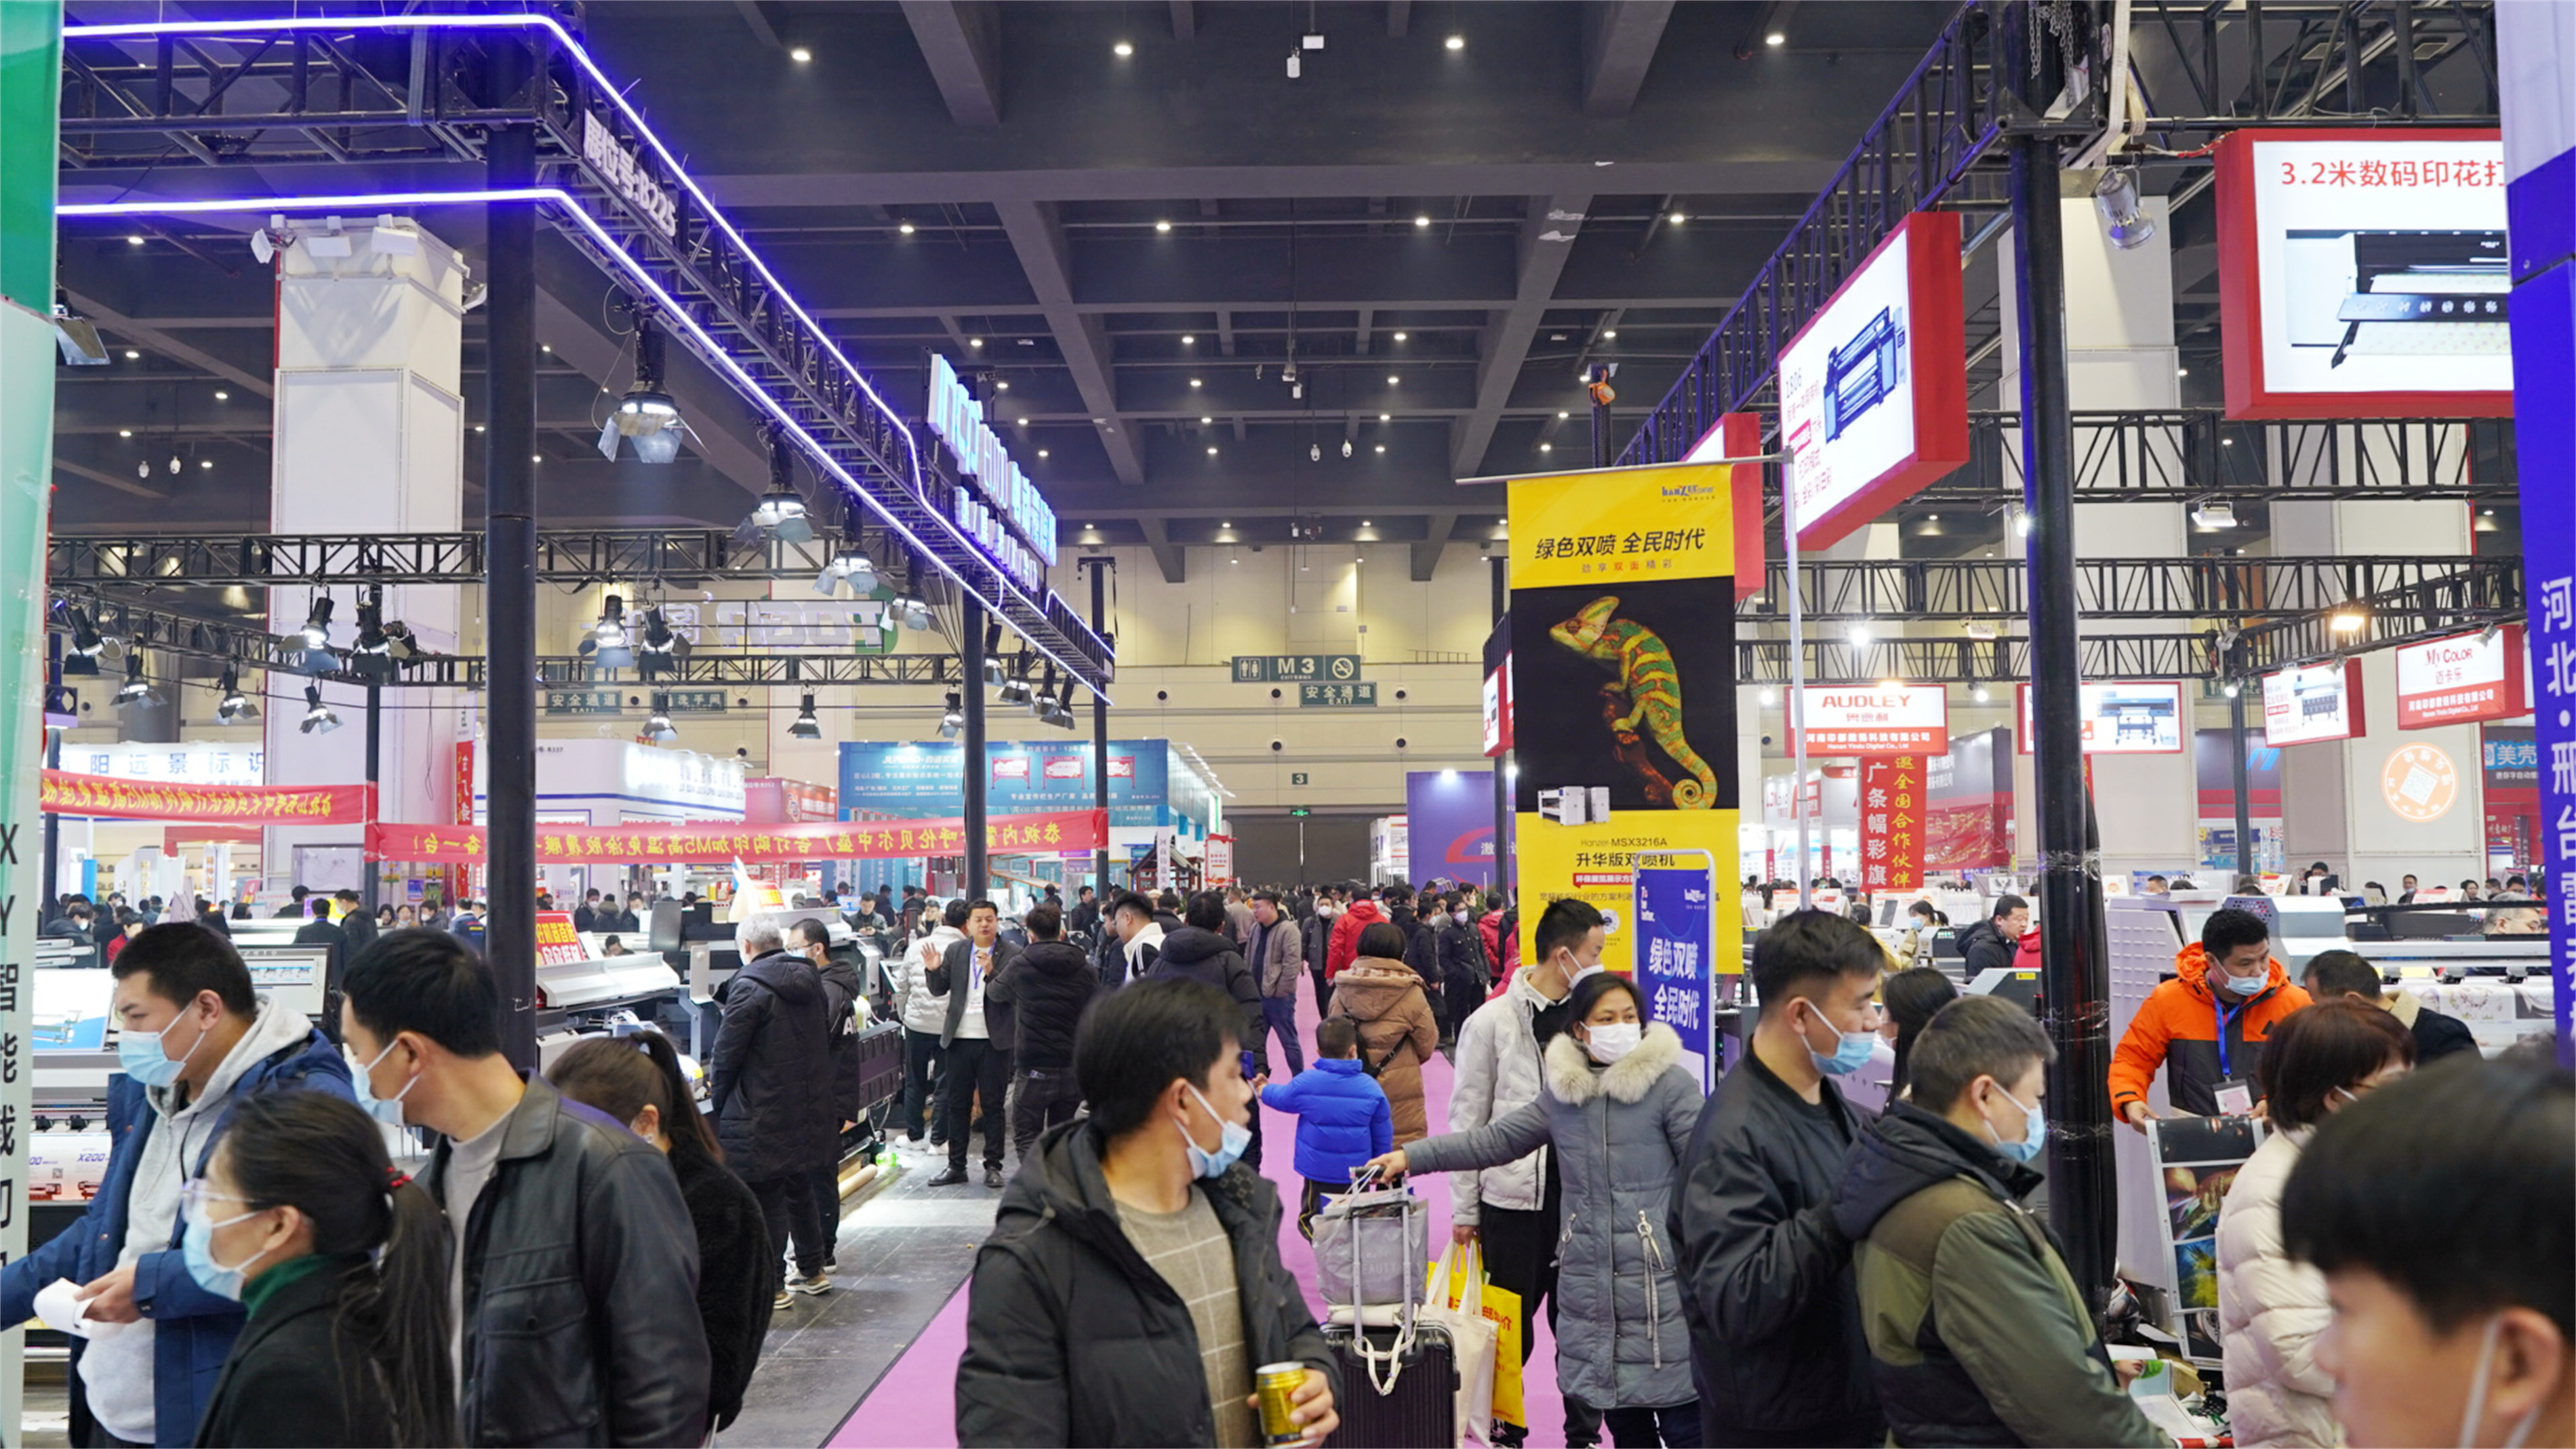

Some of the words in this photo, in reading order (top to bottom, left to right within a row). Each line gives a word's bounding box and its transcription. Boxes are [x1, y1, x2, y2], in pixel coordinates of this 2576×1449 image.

[1535, 534, 1616, 559] 绿色双喷
[1622, 528, 1706, 554] 全民时代
[1582, 559, 1672, 574] 劲享双面精彩
[1306, 685, 1371, 699] 安全通道
[552, 694, 617, 707] 安全通道
[1822, 694, 1911, 708] AUDLEY
[1295, 774, 1304, 784] 3
[1576, 852, 1675, 868] 升华版双喷机
[1649, 936, 1699, 981] 绿色双喷
[1653, 984, 1699, 1031] 全民时代
